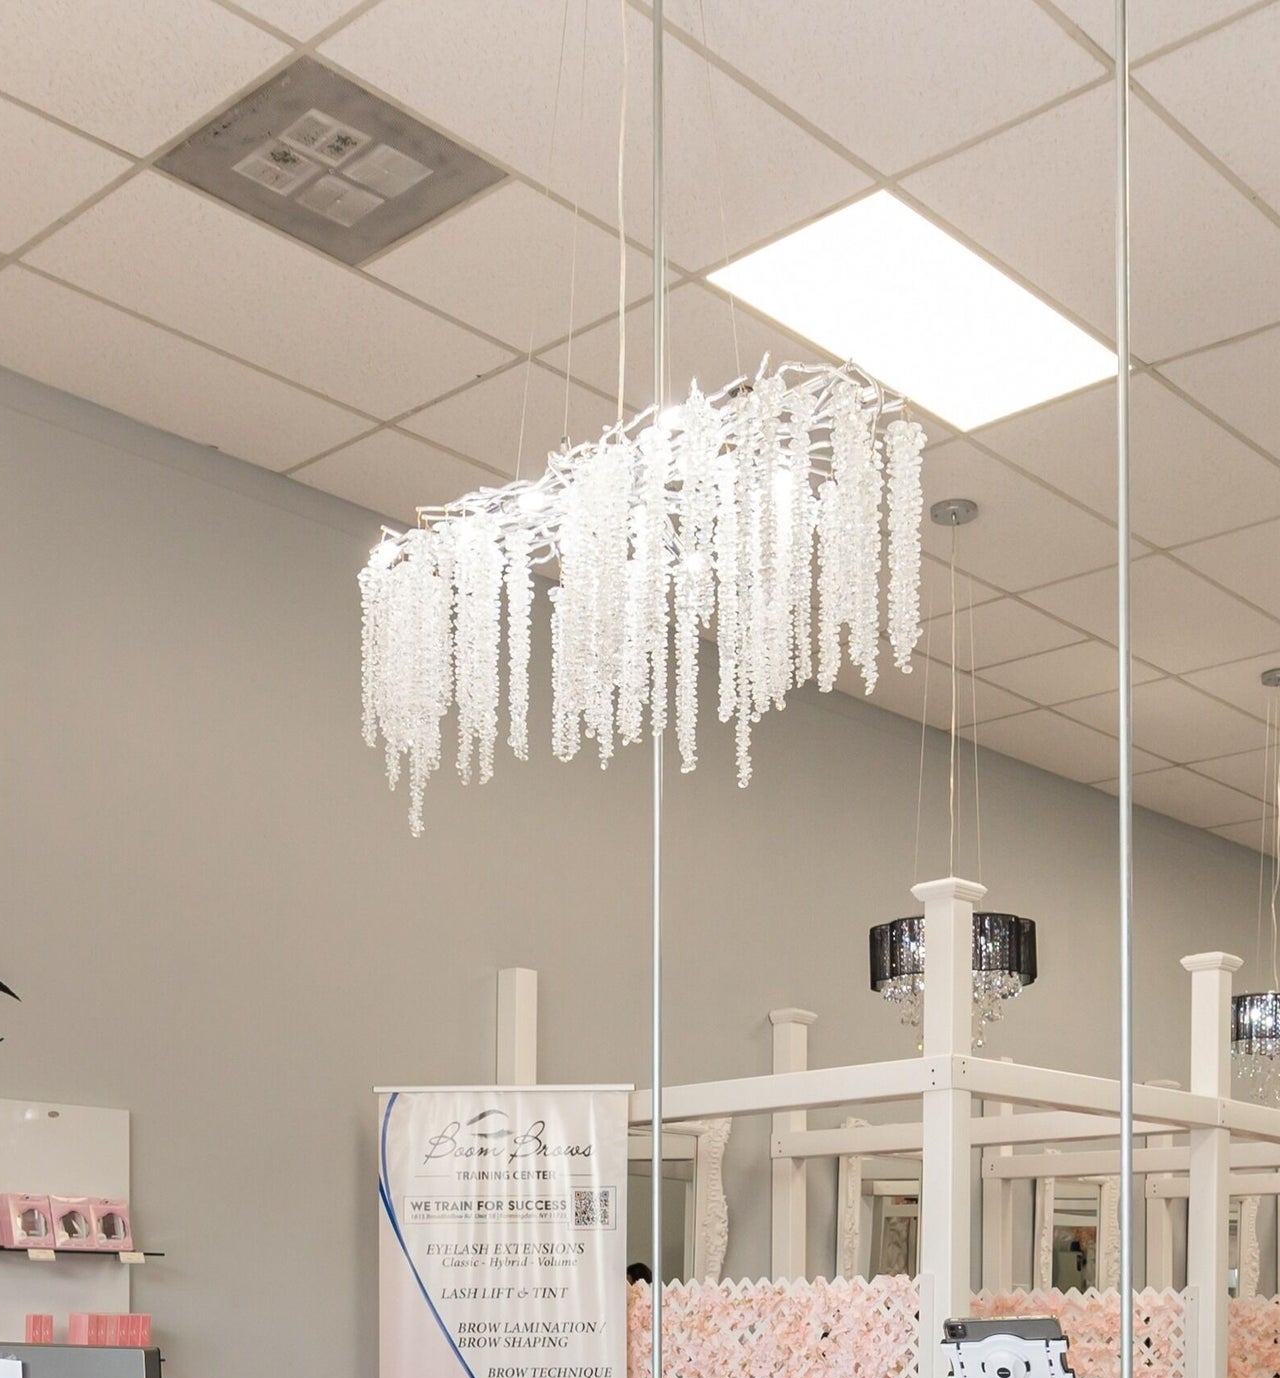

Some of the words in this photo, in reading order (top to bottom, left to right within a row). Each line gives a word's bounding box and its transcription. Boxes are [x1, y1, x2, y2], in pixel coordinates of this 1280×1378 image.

[424, 1121, 504, 1165] Boom
[508, 1120, 592, 1164] Brows
[457, 1171, 509, 1180] TRAINING
[513, 1171, 556, 1180] CENTER
[411, 1201, 431, 1211] WE
[435, 1201, 472, 1211] TRAIN
[477, 1201, 503, 1211] FOR
[508, 1200, 567, 1211] SUCCESS
[427, 1243, 489, 1255] EYELASH
[494, 1243, 584, 1254] EXTENSIONS
[442, 1257, 479, 1268] Classic
[489, 1257, 528, 1270] Hybrid
[538, 1257, 578, 1267] Volume
[441, 1288, 478, 1299] LASH
[482, 1288, 514, 1299] LIFT
[517, 1289, 528, 1299] &
[533, 1287, 568, 1299] TINT
[458, 1322, 500, 1333] BROW
[504, 1322, 597, 1333] LAMINATION
[458, 1337, 500, 1348] BROW
[504, 1337, 568, 1348] SHAPING
[488, 1368, 528, 1378] BROW
[531, 1367, 612, 1378] TECHNIQUE
